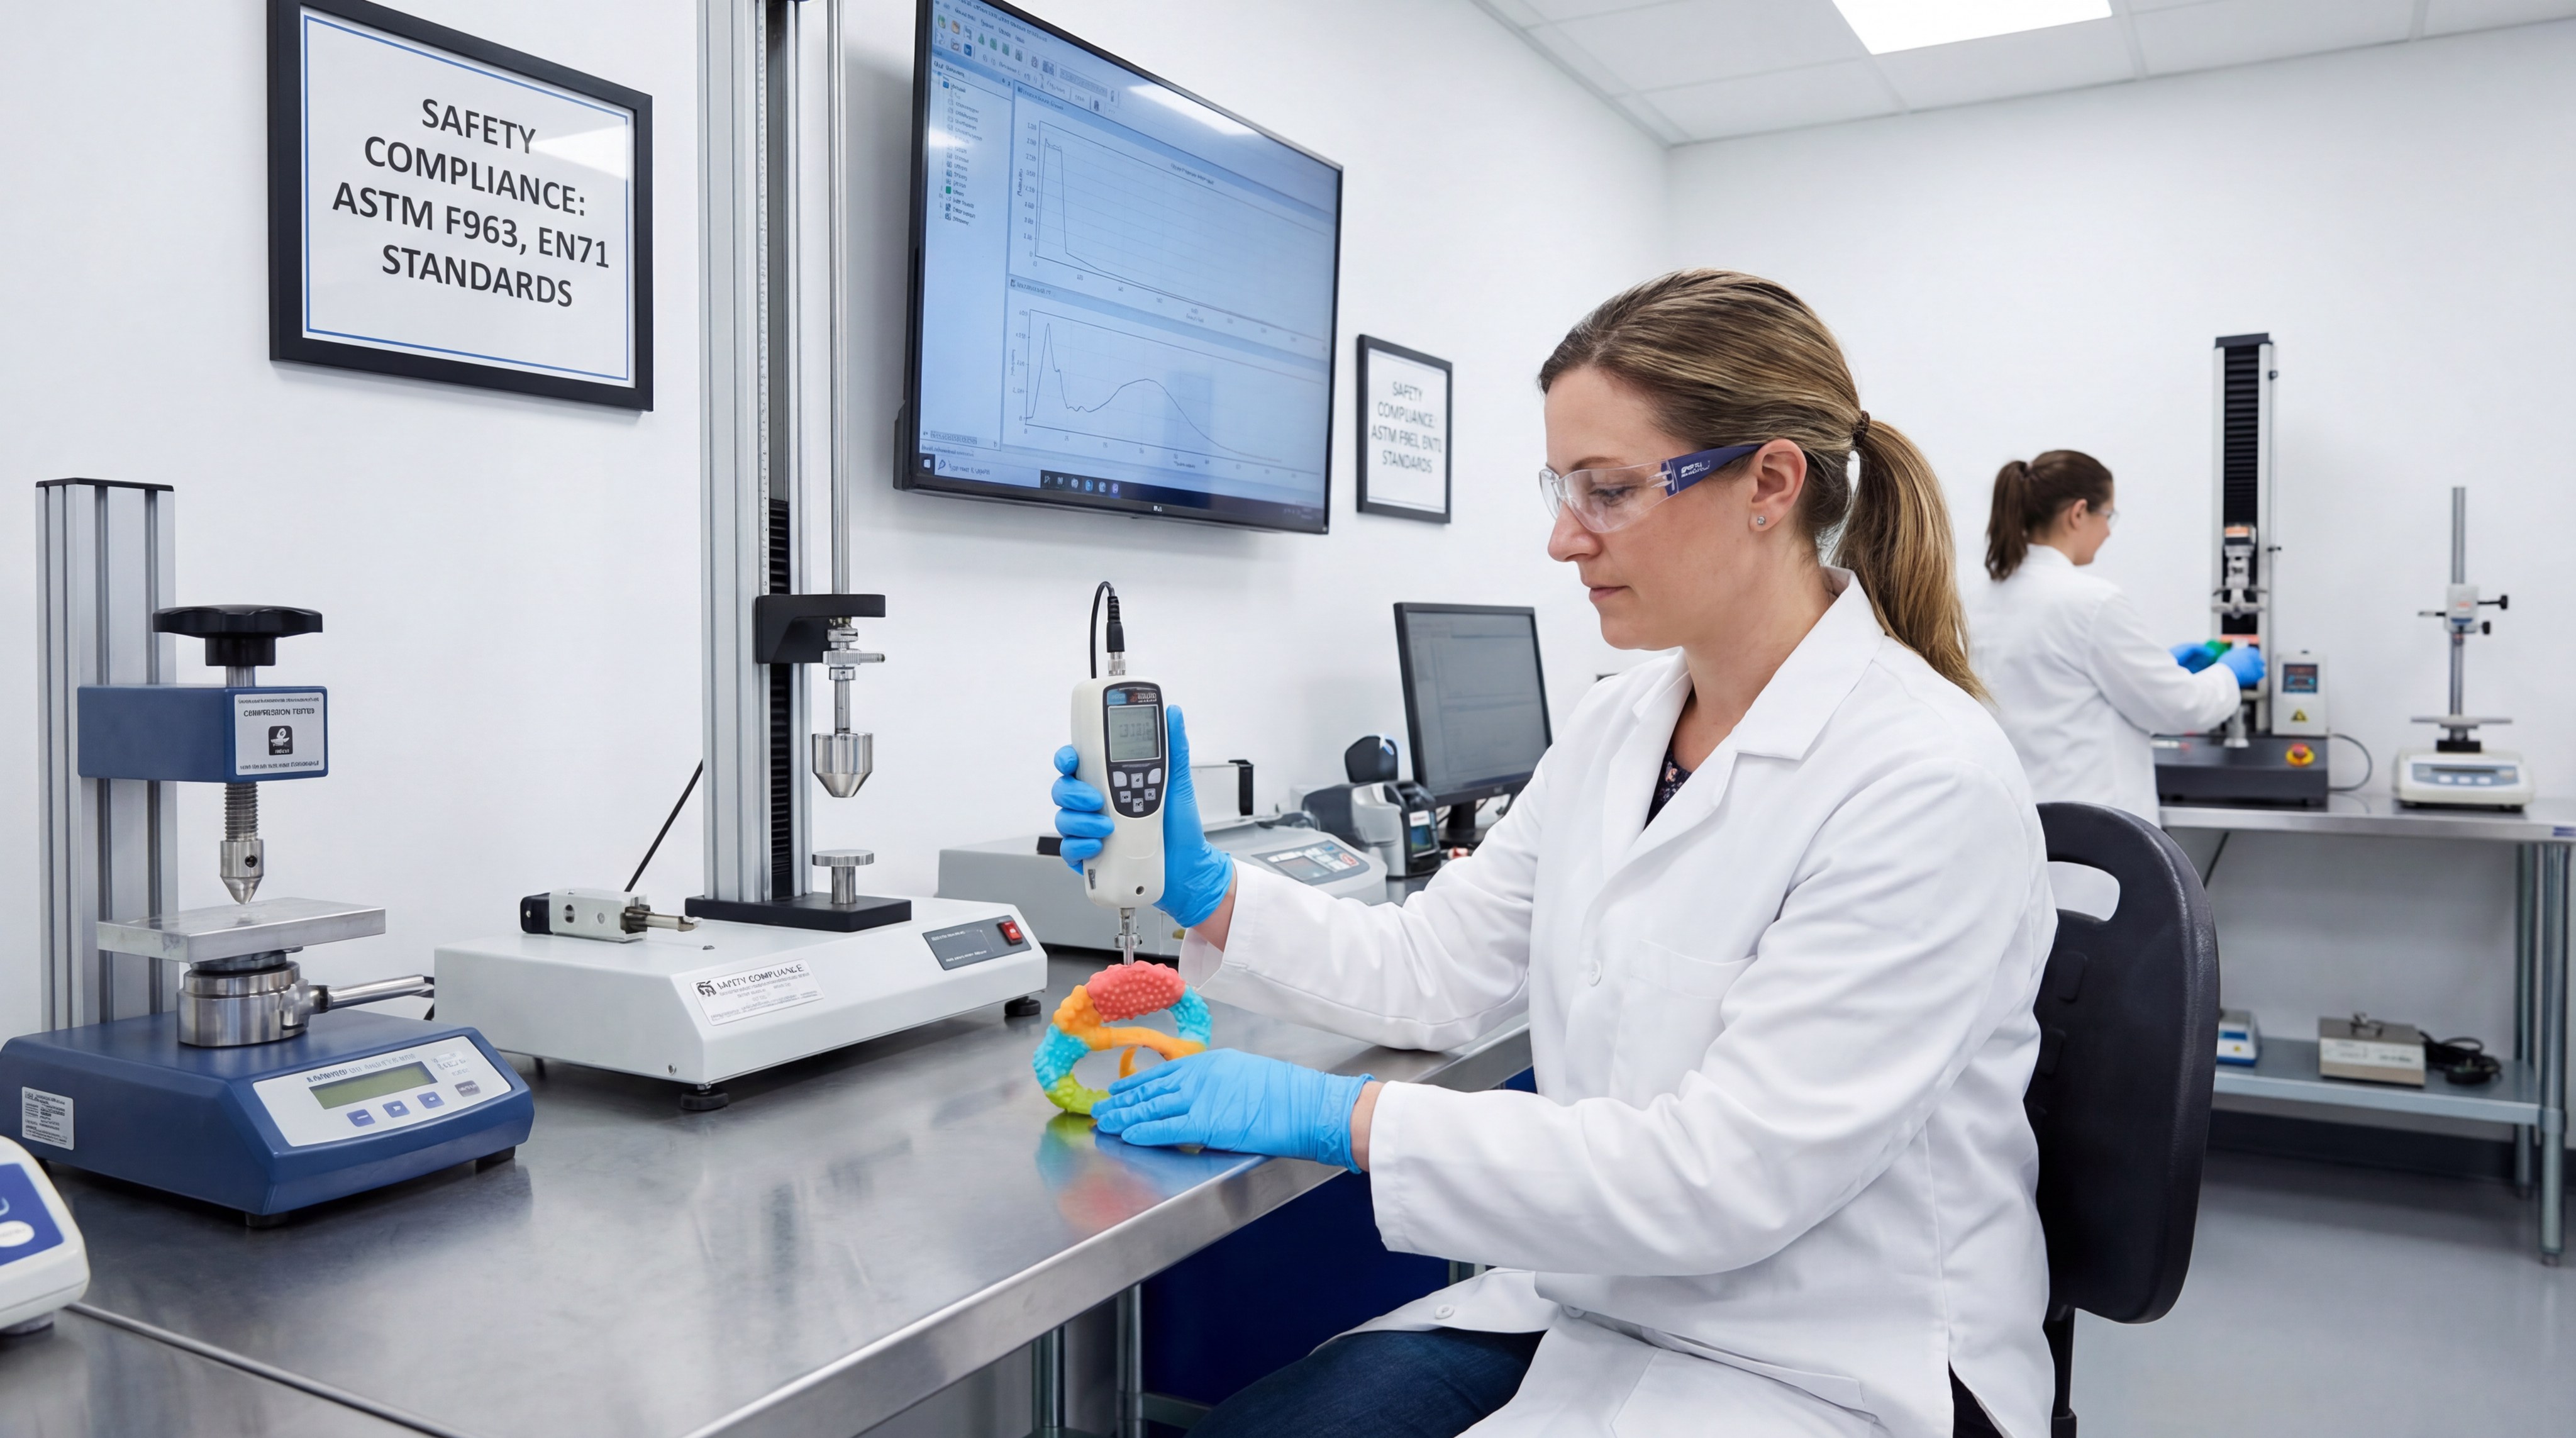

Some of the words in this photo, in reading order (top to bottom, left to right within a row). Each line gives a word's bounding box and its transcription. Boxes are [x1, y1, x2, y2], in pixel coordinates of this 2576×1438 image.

[422, 99, 536, 154] SAFETY
[365, 136, 585, 216] COMPLIANCE:
[332, 182, 433, 231] ASTM
[445, 205, 526, 255] F963,
[539, 226, 609, 269] EN71
[382, 245, 572, 307] STANDARDS
[1392, 381, 1423, 401] SAFETY
